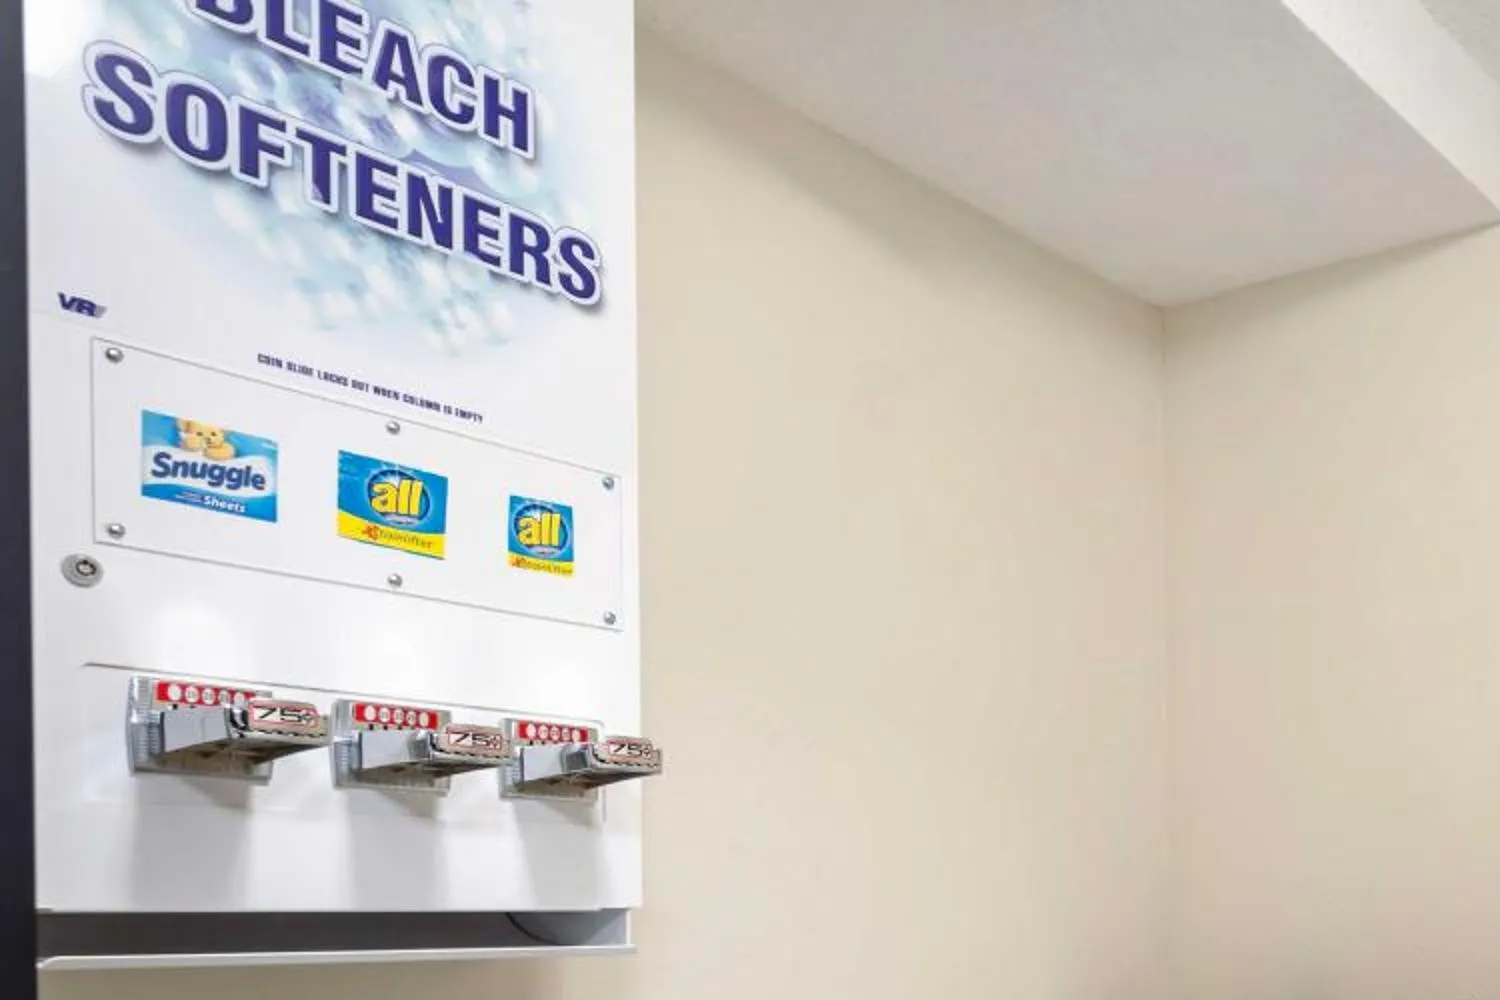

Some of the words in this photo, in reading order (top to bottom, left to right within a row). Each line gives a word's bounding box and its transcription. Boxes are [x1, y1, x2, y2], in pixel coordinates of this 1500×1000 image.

[196, 0, 529, 152] LEACH
[93, 52, 598, 301] SOFTENERS
[151, 451, 266, 491] Snuggle
[203, 495, 246, 513] Sheets
[371, 479, 424, 516] all
[518, 511, 561, 546] all
